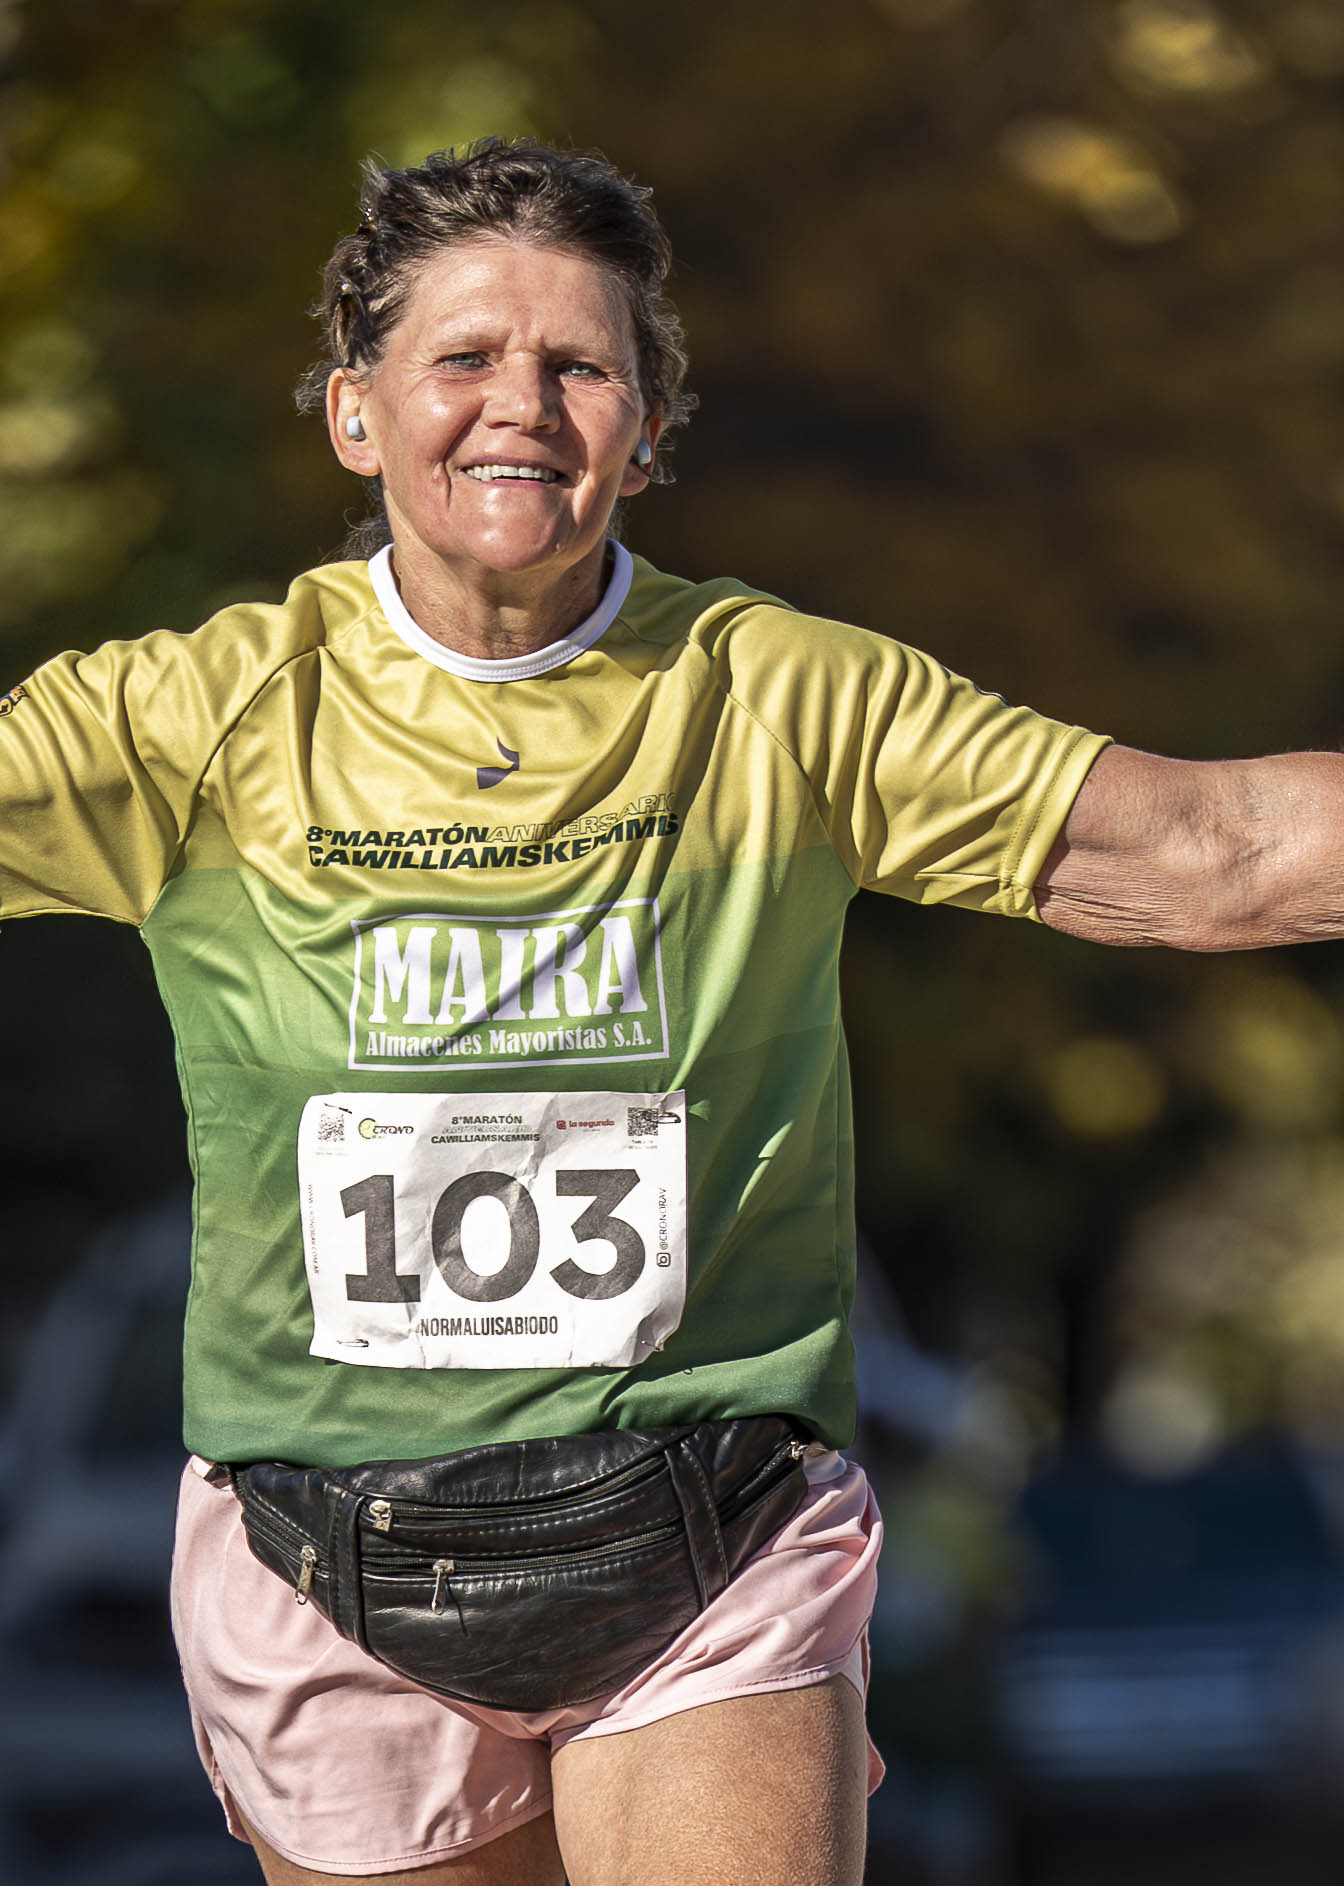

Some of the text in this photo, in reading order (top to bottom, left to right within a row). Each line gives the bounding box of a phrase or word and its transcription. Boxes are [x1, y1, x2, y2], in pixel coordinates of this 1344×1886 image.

[367, 916, 648, 1025] MAIRA
[365, 1021, 652, 1057] Almacenes Mayoristas S.A.
[578, 1119, 616, 1129] segunda
[431, 1133, 541, 1144] CAWILLIAMSKEMMIS
[339, 1168, 646, 1303] 103
[420, 1315, 558, 1336] NORMALUISABIODO
